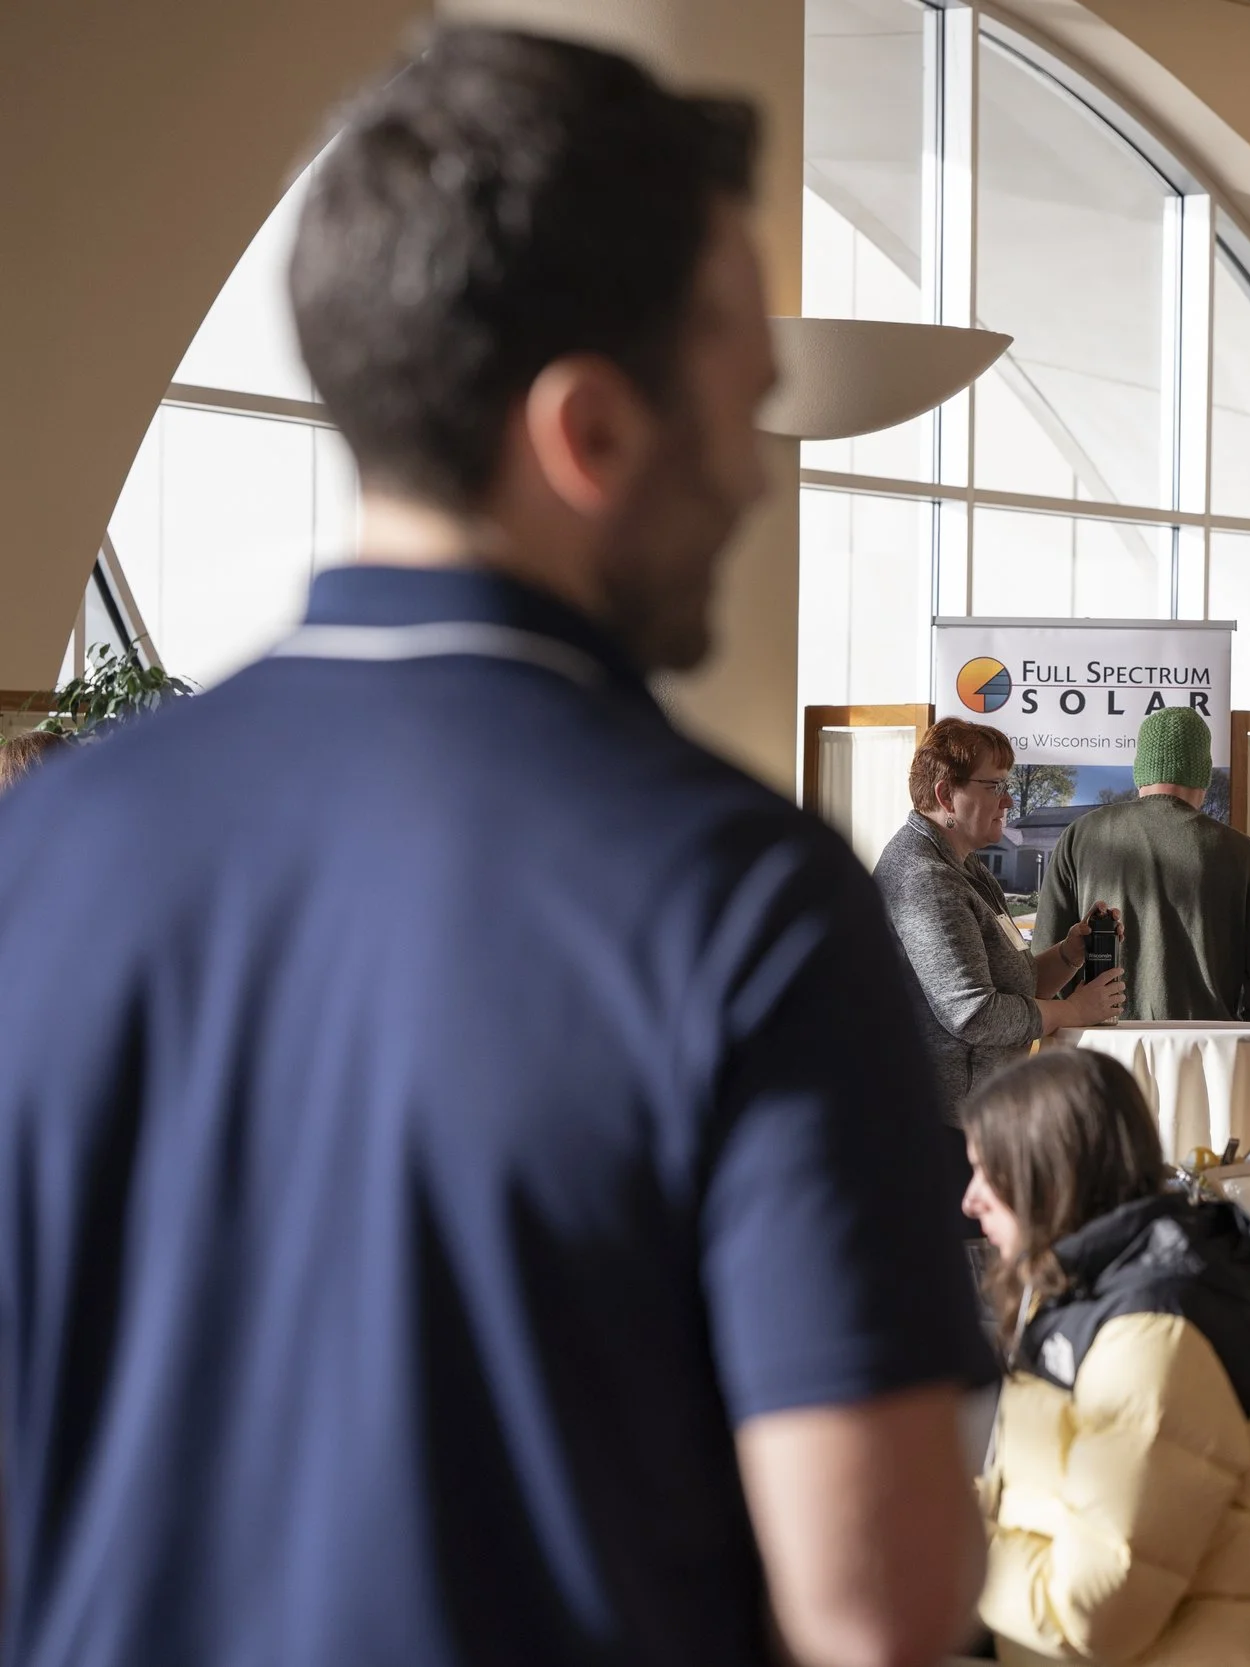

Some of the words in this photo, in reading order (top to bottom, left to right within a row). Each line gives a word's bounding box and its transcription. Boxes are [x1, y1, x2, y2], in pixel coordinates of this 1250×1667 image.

[1022, 689, 1211, 716] SOLAR
[1032, 733, 1111, 749] Wisconsin
[1115, 734, 1136, 749] sin
